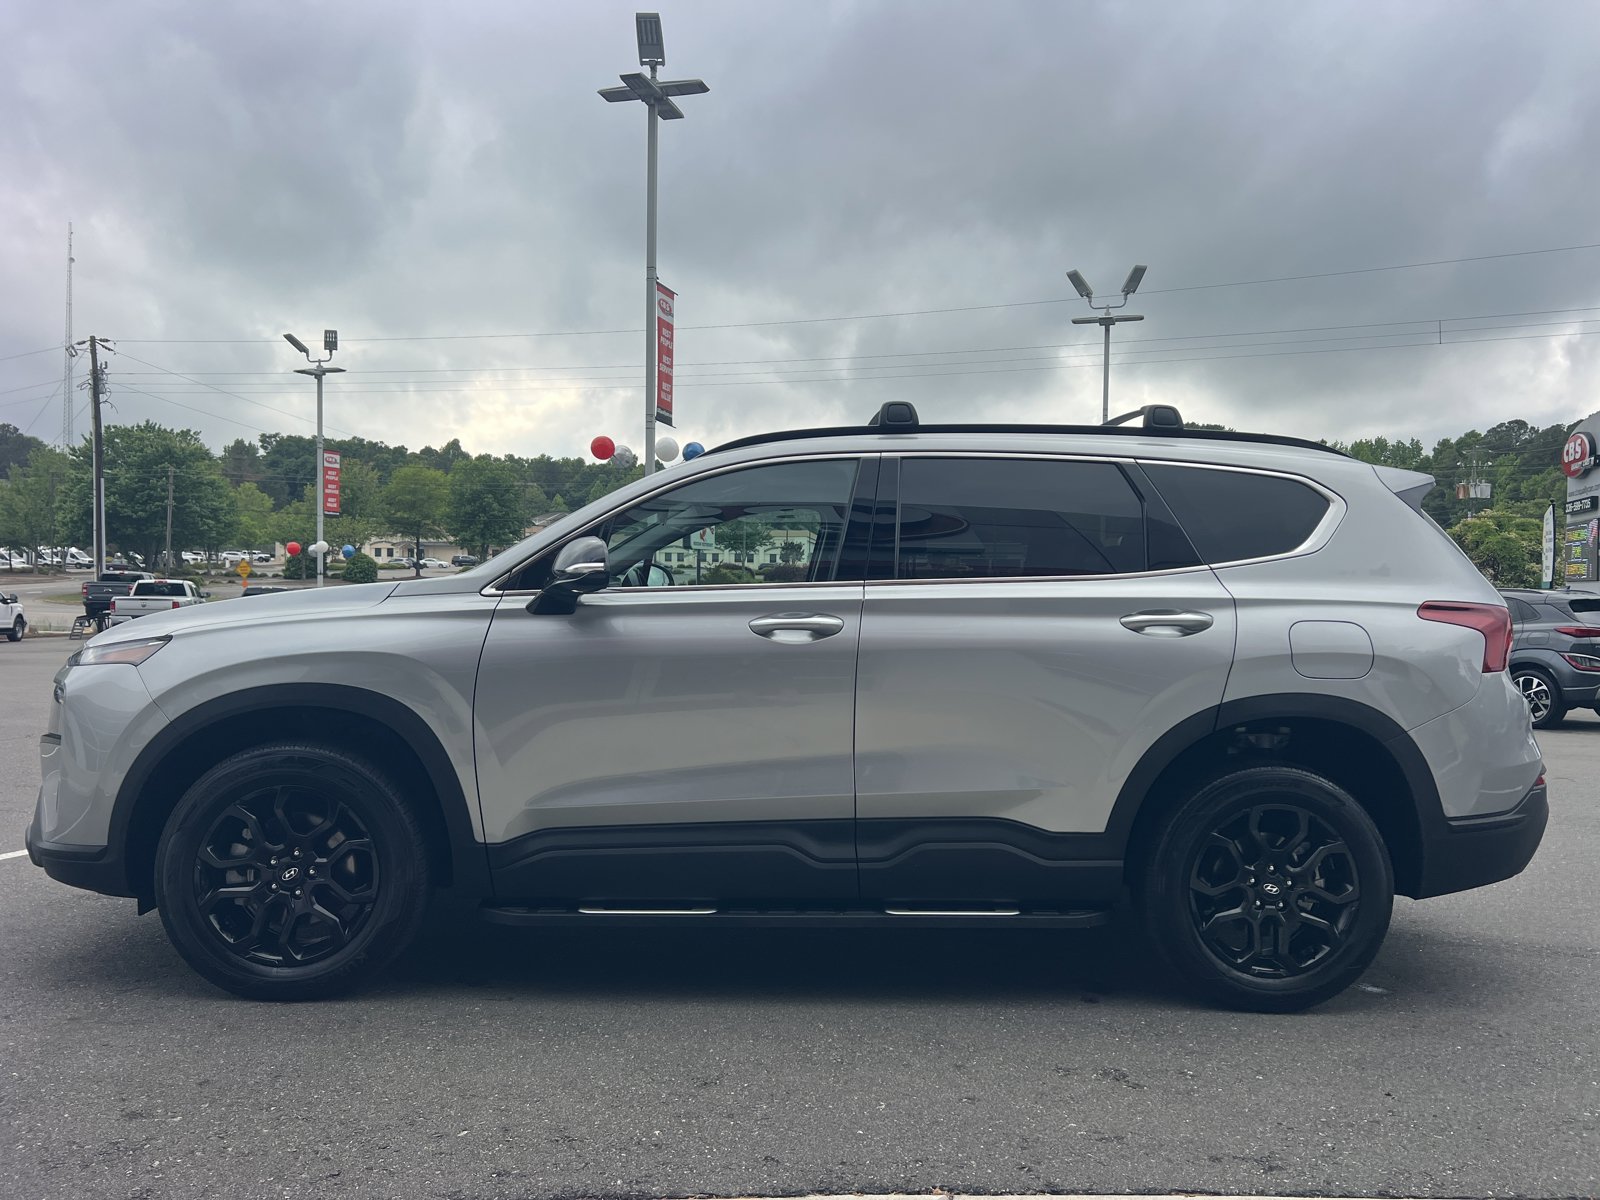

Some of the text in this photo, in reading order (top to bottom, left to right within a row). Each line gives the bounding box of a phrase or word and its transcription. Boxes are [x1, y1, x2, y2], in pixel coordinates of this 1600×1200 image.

[662, 328, 671, 338] BEST
[662, 354, 671, 366] BEST
[662, 381, 671, 392] BEST
[1564, 438, 1582, 462] CBS
